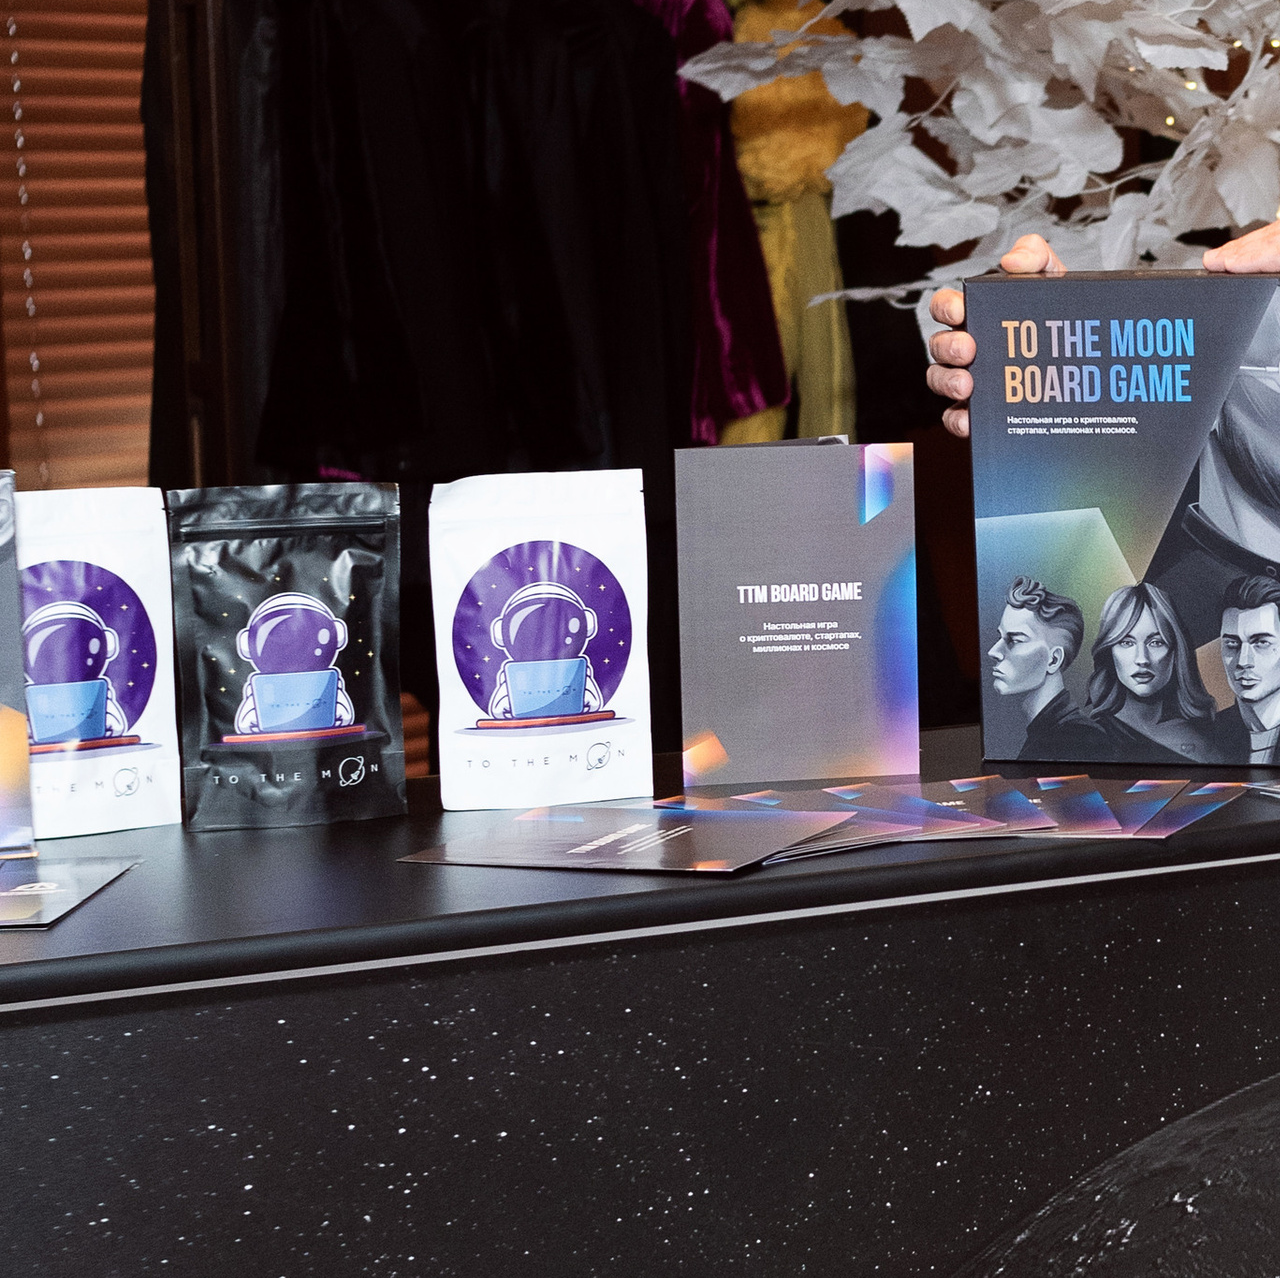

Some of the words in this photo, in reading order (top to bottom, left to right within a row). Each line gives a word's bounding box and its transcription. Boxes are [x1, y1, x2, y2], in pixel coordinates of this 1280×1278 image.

[1001, 319, 1039, 359] TO
[1045, 319, 1102, 358] THE
[1110, 318, 1195, 358] MOON
[1004, 364, 1102, 404] BOARD
[1109, 363, 1192, 403] GAME
[1006, 416, 1053, 424] Настольная
[1054, 417, 1073, 425] игра
[1080, 416, 1139, 425] криптовалюте,
[1007, 426, 1050, 435] стартапах,
[1050, 426, 1094, 434] миллионах
[1102, 426, 1138, 434] космосе.
[737, 585, 768, 603] TTM
[770, 583, 819, 602] BOARD
[821, 582, 863, 601] GAME
[763, 622, 816, 631] Настольная
[817, 621, 838, 630] игра
[739, 635, 746, 643] о
[747, 633, 813, 644] криптовалюте,
[814, 631, 862, 641] стартапах,
[752, 644, 802, 653] миллионах
[803, 643, 810, 651] и
[811, 642, 850, 651] космосе
[467, 759, 491, 769] TO
[512, 756, 550, 768] THE
[213, 775, 239, 785] TO
[260, 772, 302, 783] THE
